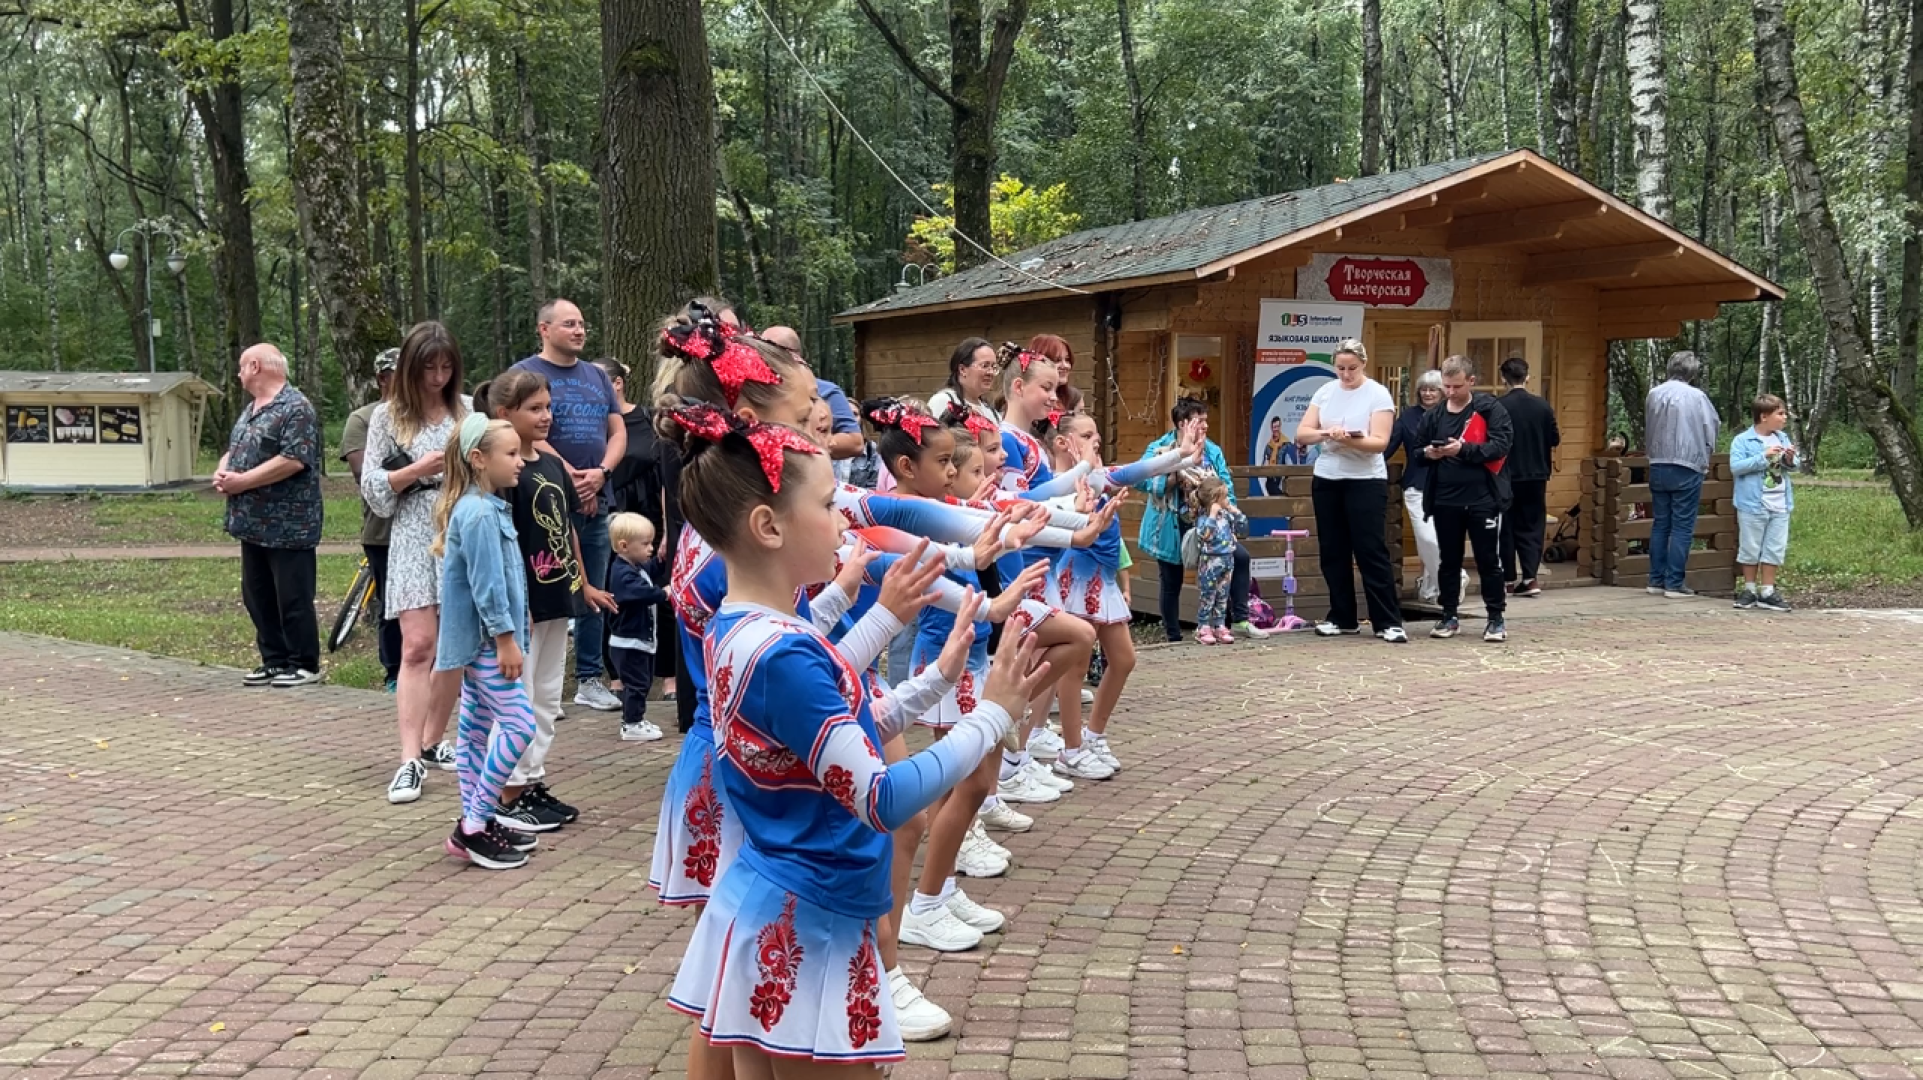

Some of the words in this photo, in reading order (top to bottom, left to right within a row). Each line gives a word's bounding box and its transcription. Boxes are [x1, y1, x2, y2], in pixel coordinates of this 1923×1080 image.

[1343, 264, 1411, 283] Творческая
[1268, 334, 1310, 343] ЯЗЫКОВАЯ
[1311, 335, 1340, 344] ШКОЛА
